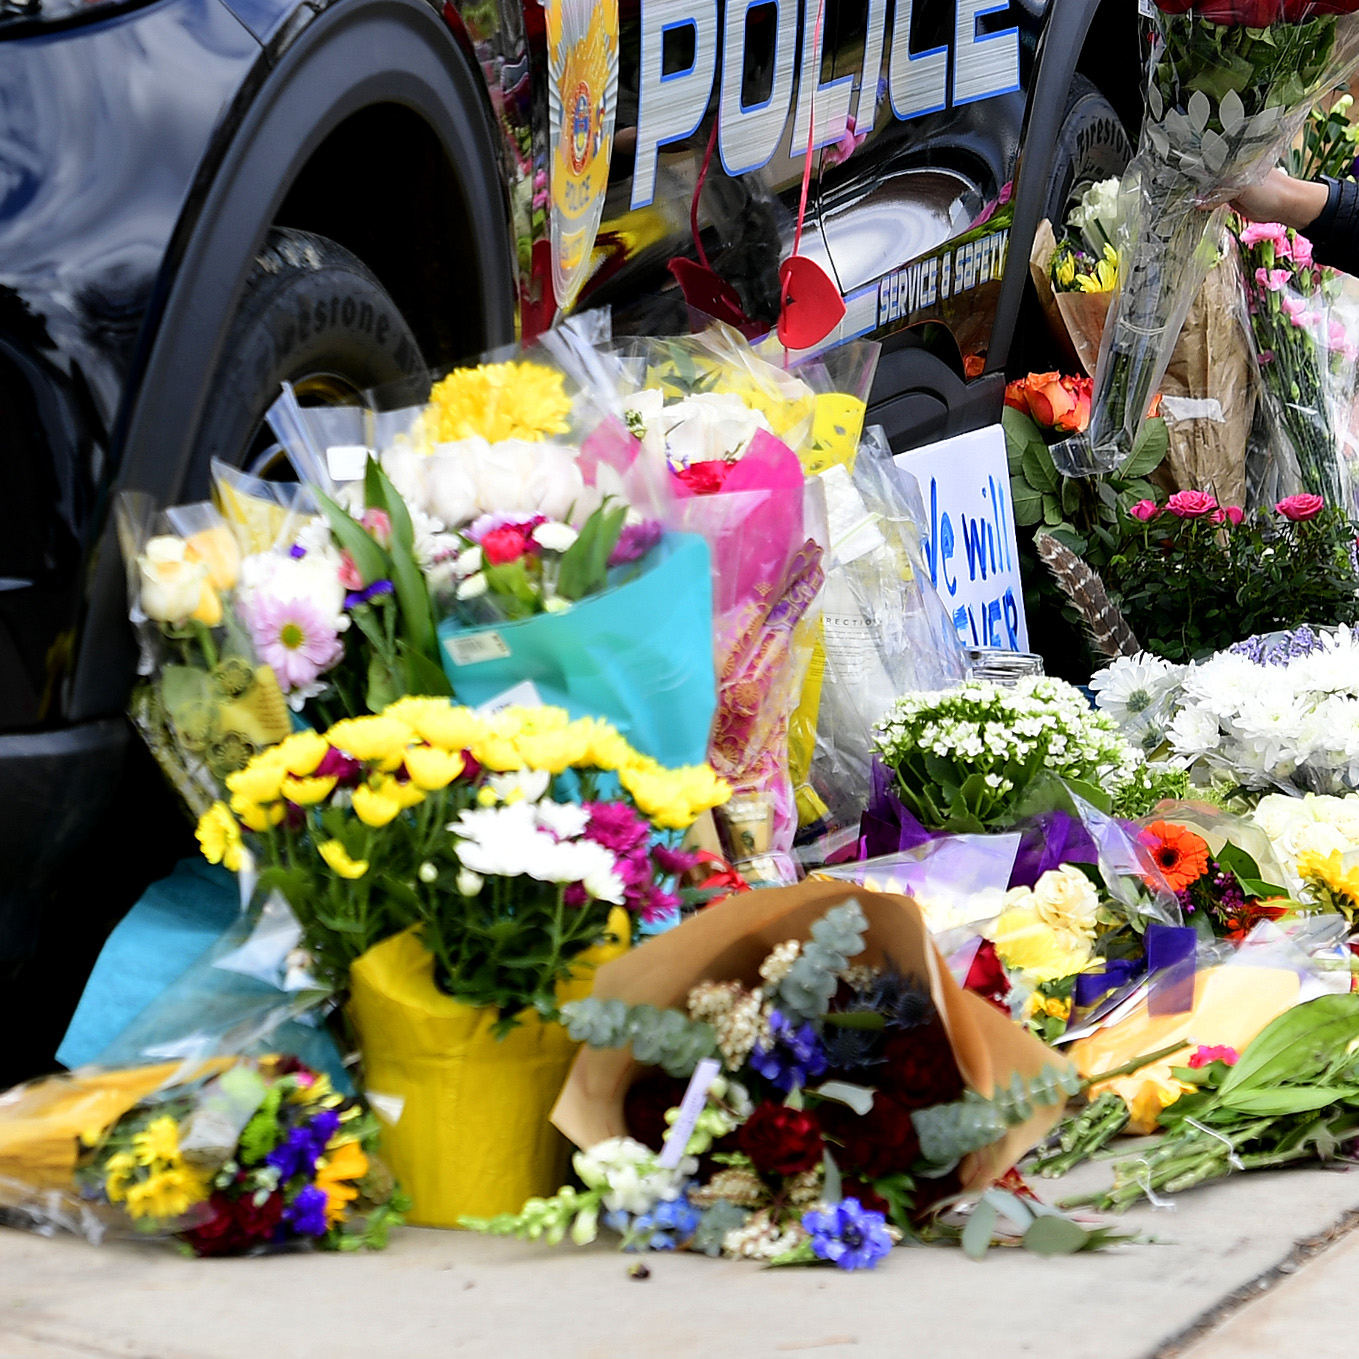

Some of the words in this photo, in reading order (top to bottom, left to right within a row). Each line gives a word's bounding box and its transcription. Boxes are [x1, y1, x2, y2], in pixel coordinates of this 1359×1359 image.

[879, 256, 938, 326] SERVICE
[954, 229, 1010, 295] SAFETY
[961, 474, 1011, 581] will
[944, 586, 1020, 652] EVER
